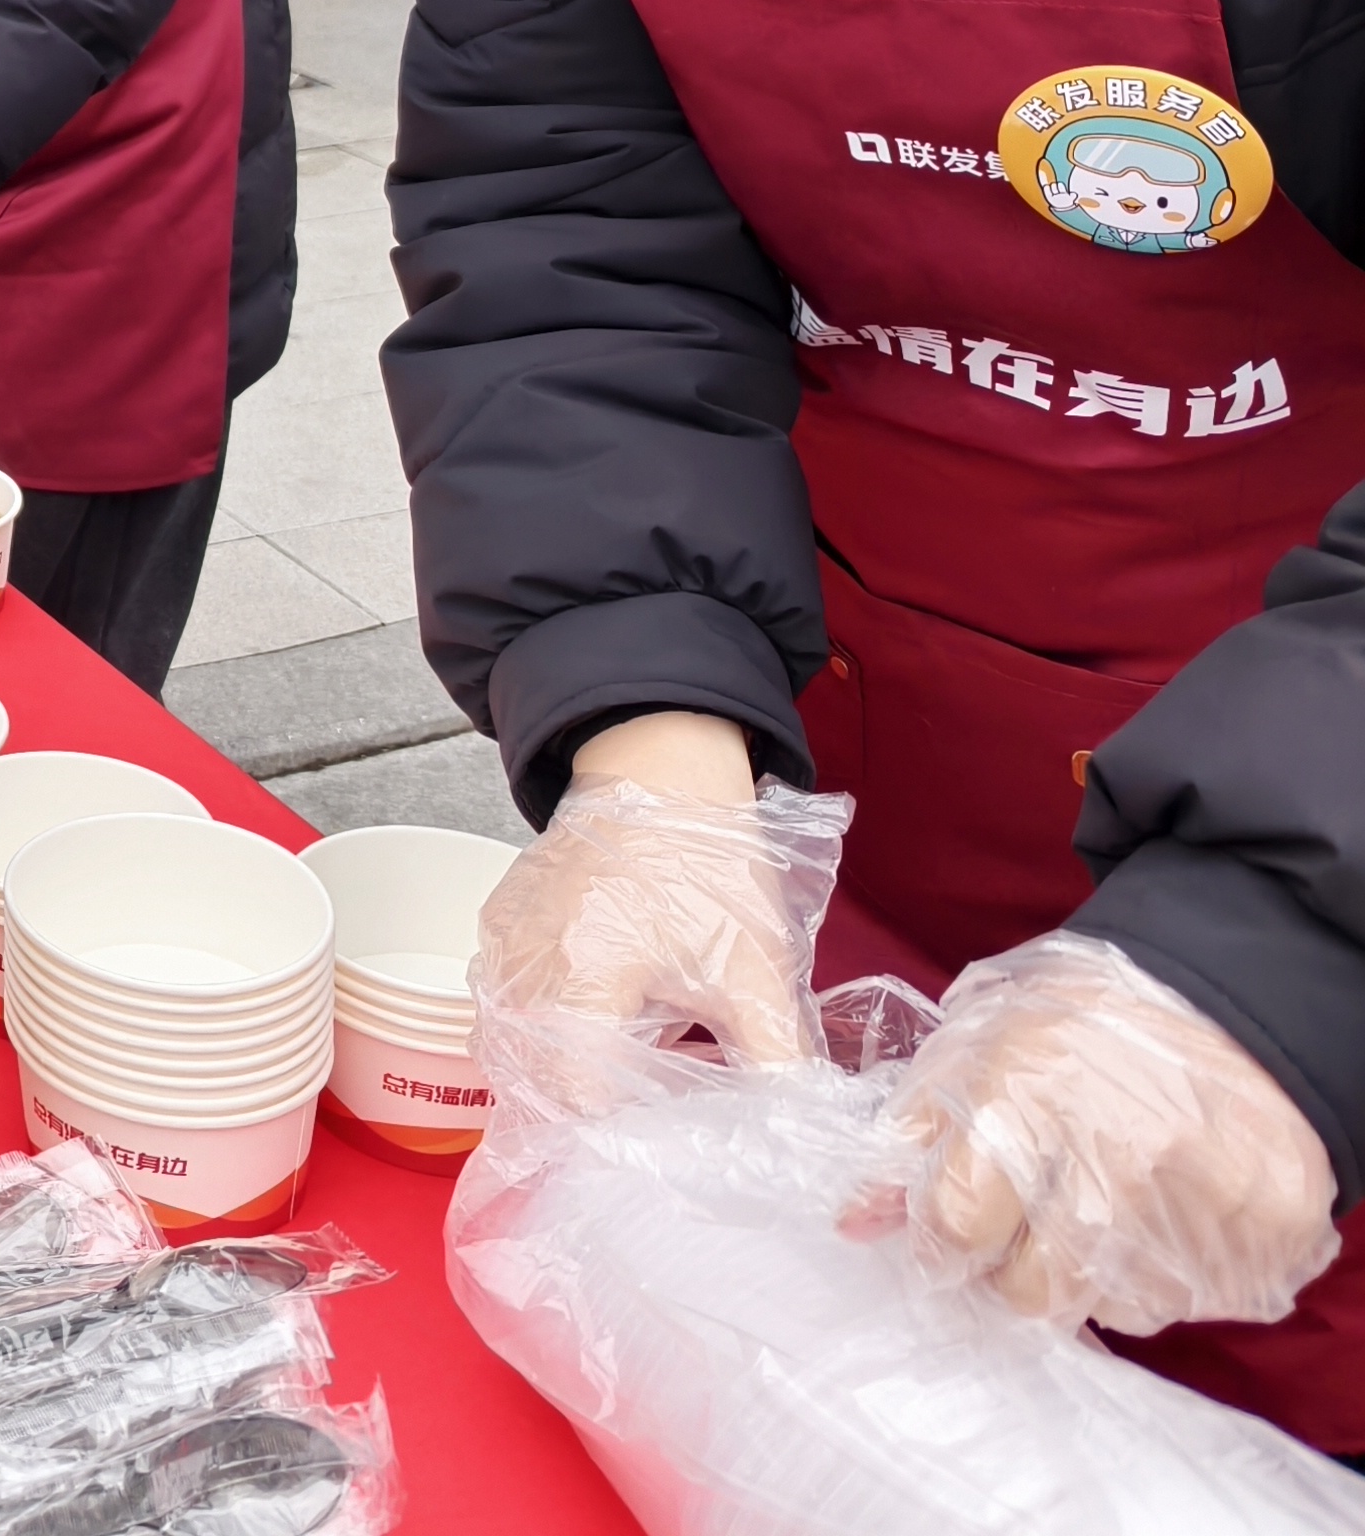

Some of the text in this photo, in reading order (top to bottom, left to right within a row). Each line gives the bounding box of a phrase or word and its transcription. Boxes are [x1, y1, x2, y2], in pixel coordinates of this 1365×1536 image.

[1015, 77, 1246, 148] 联发服务官
[382, 1072, 496, 1107] 总有温情
